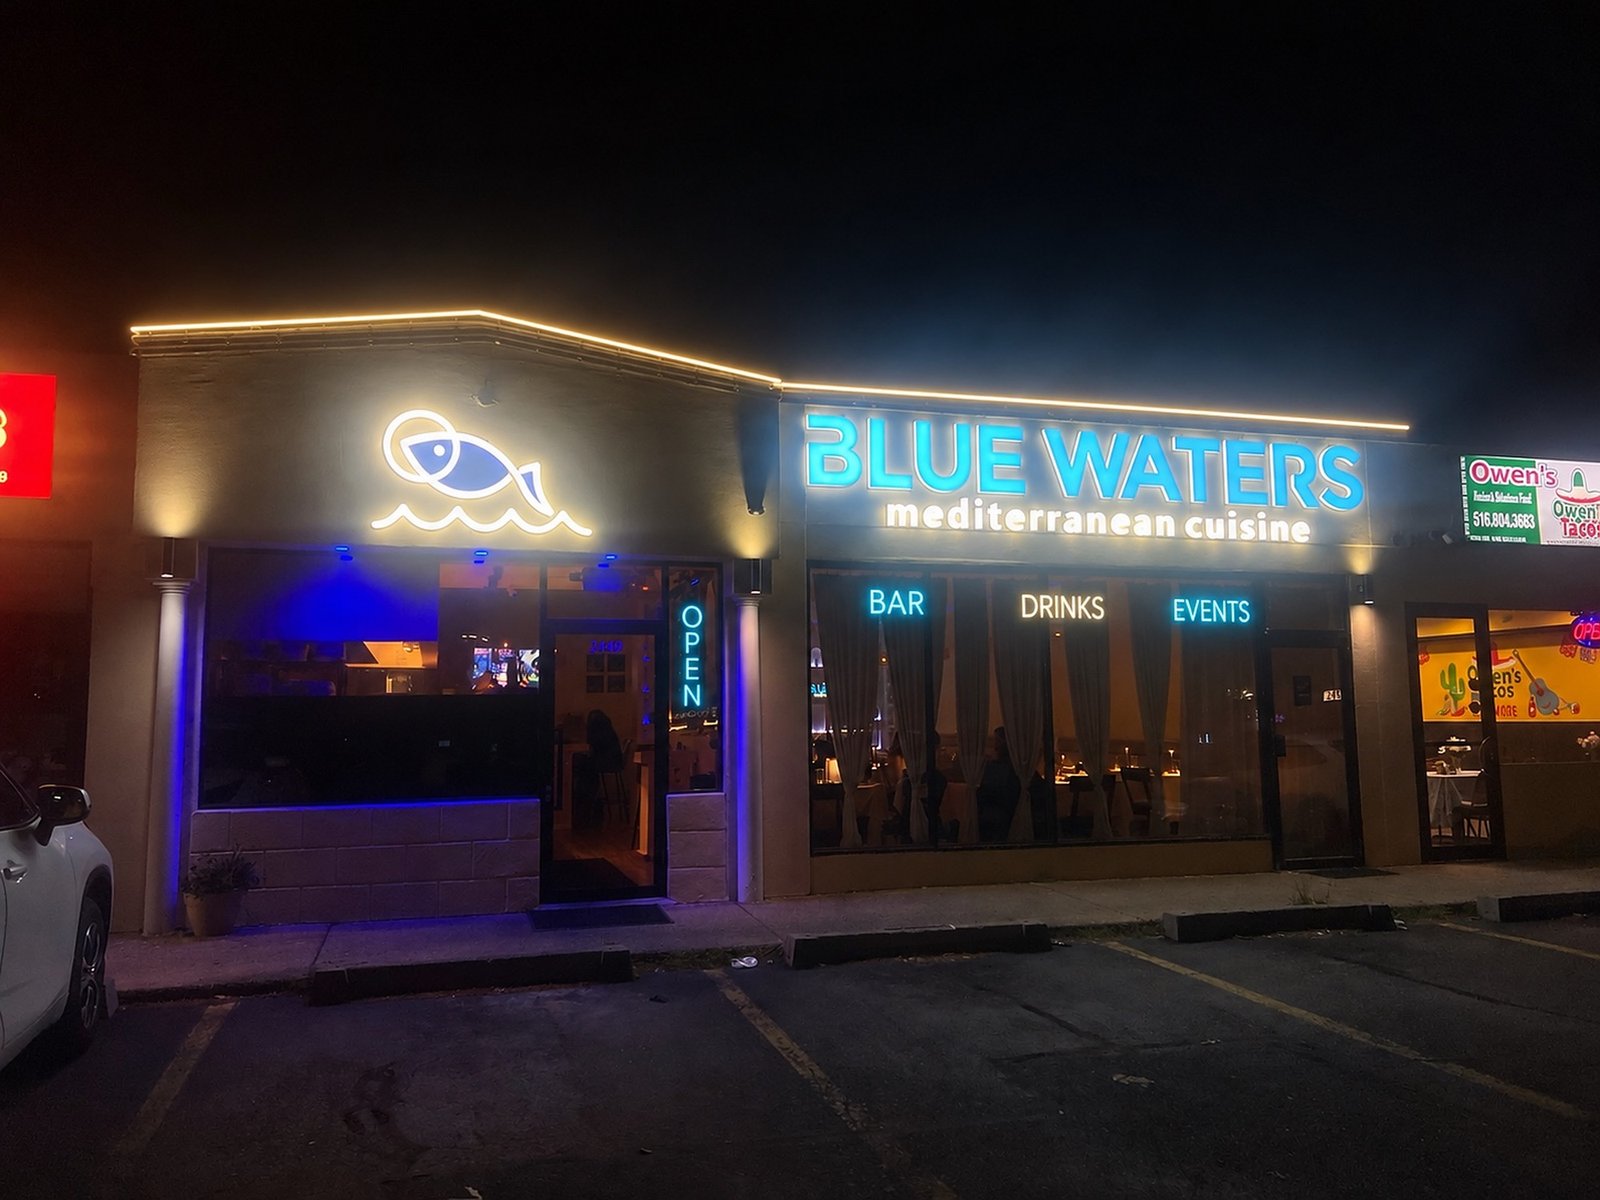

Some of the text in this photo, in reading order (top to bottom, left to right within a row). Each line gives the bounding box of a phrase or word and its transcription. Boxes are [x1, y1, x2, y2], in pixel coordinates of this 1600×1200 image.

[806, 413, 1027, 495] BLUE
[1041, 429, 1365, 512] WATERS
[1470, 461, 1557, 487] Owen's
[886, 498, 1311, 543] mediterranean cuisine
[868, 588, 925, 616] BAR
[1020, 593, 1105, 620] DRINKS
[1172, 597, 1251, 623] EVENTS
[681, 604, 703, 707] OPEN
